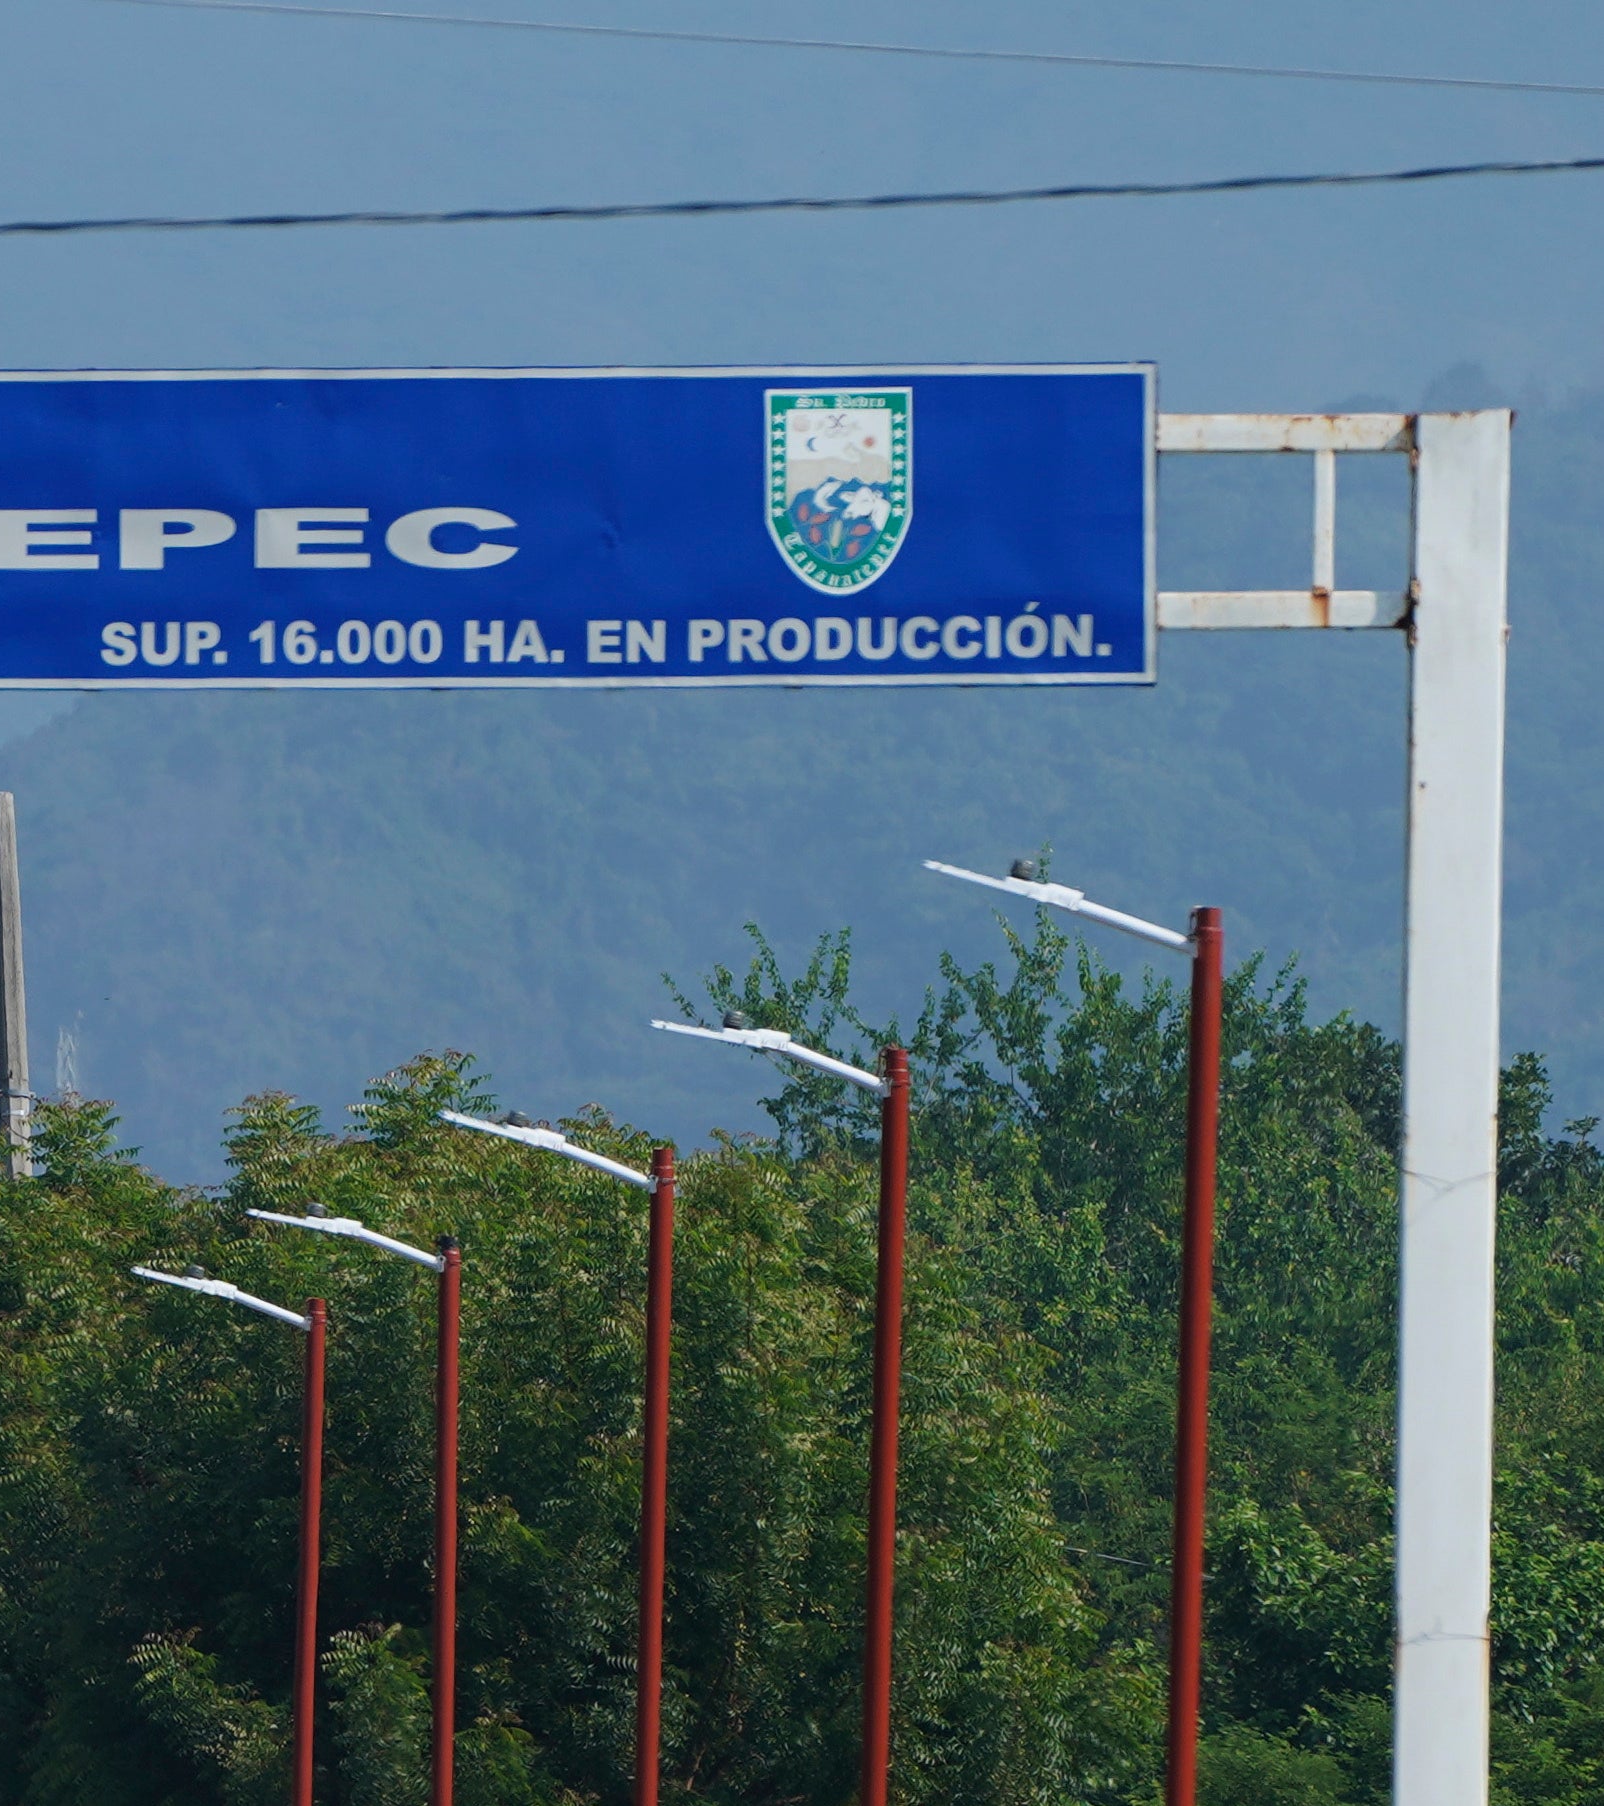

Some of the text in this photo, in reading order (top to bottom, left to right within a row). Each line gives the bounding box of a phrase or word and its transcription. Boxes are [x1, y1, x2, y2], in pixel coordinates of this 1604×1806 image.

[102, 602, 1110, 665] SUP. 16.000 HA. EN PRODUCCIÓN.
